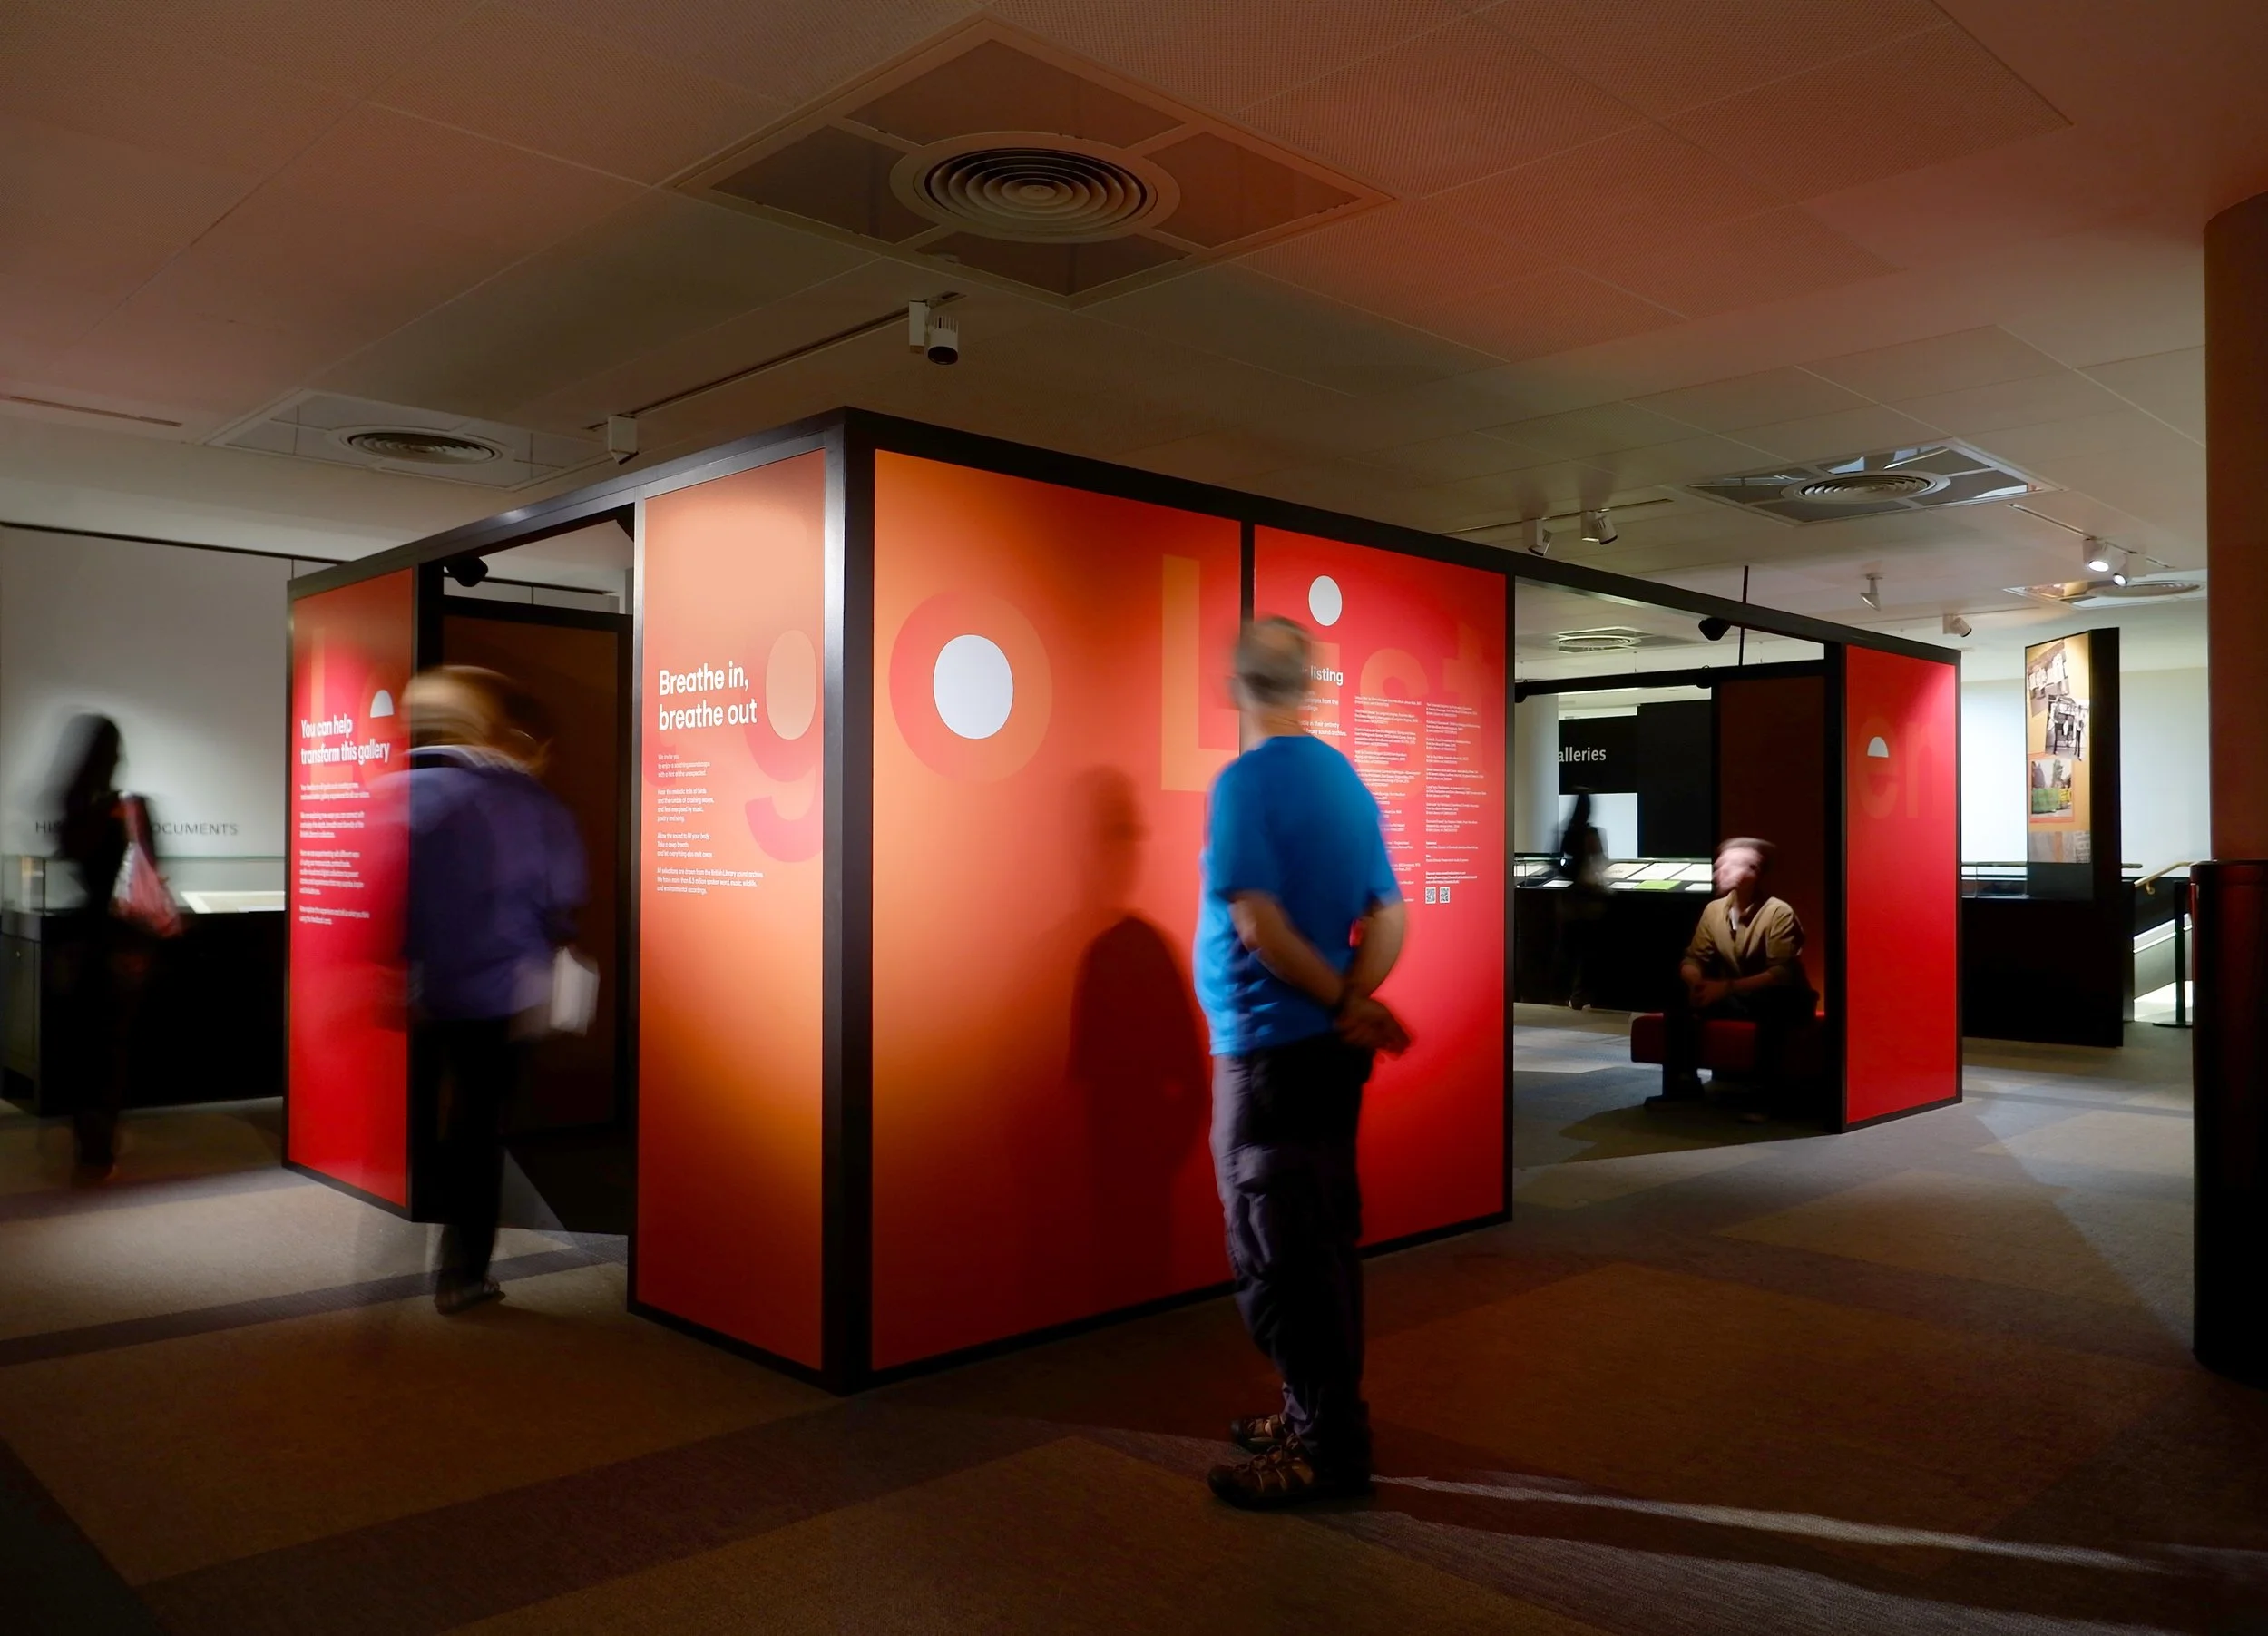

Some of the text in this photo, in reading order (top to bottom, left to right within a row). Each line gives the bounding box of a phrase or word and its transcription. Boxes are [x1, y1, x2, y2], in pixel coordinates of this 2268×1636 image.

[659, 660, 749, 696] Breathe in,
[1310, 665, 1344, 686] listing
[301, 713, 353, 739] You can help
[659, 698, 758, 730] breathe out
[300, 738, 390, 766] transform this gallery
[1558, 746, 1607, 762] alleries
[152, 822, 240, 836] OCUMENTS
